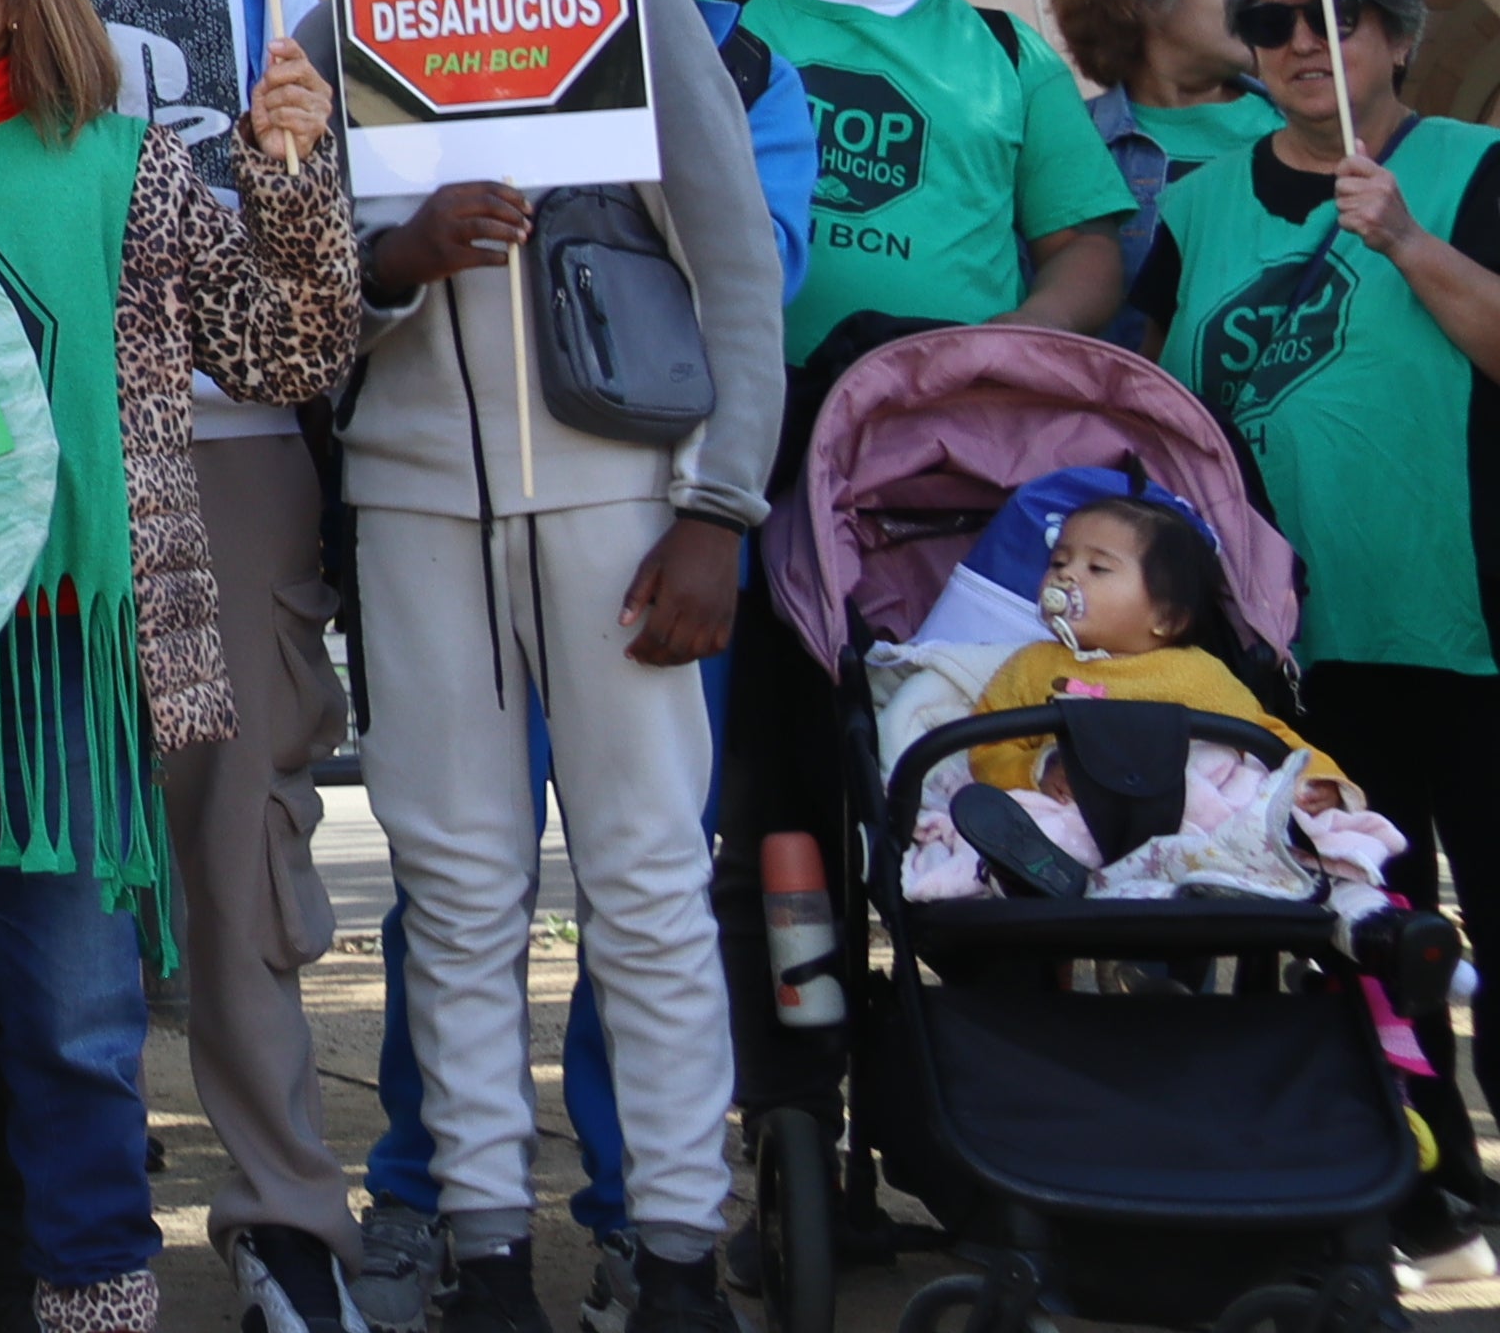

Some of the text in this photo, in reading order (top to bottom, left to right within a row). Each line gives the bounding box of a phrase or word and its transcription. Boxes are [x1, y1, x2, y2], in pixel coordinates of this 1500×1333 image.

[424, 46, 549, 76] PAH BCN
[829, 223, 911, 260] BCN
